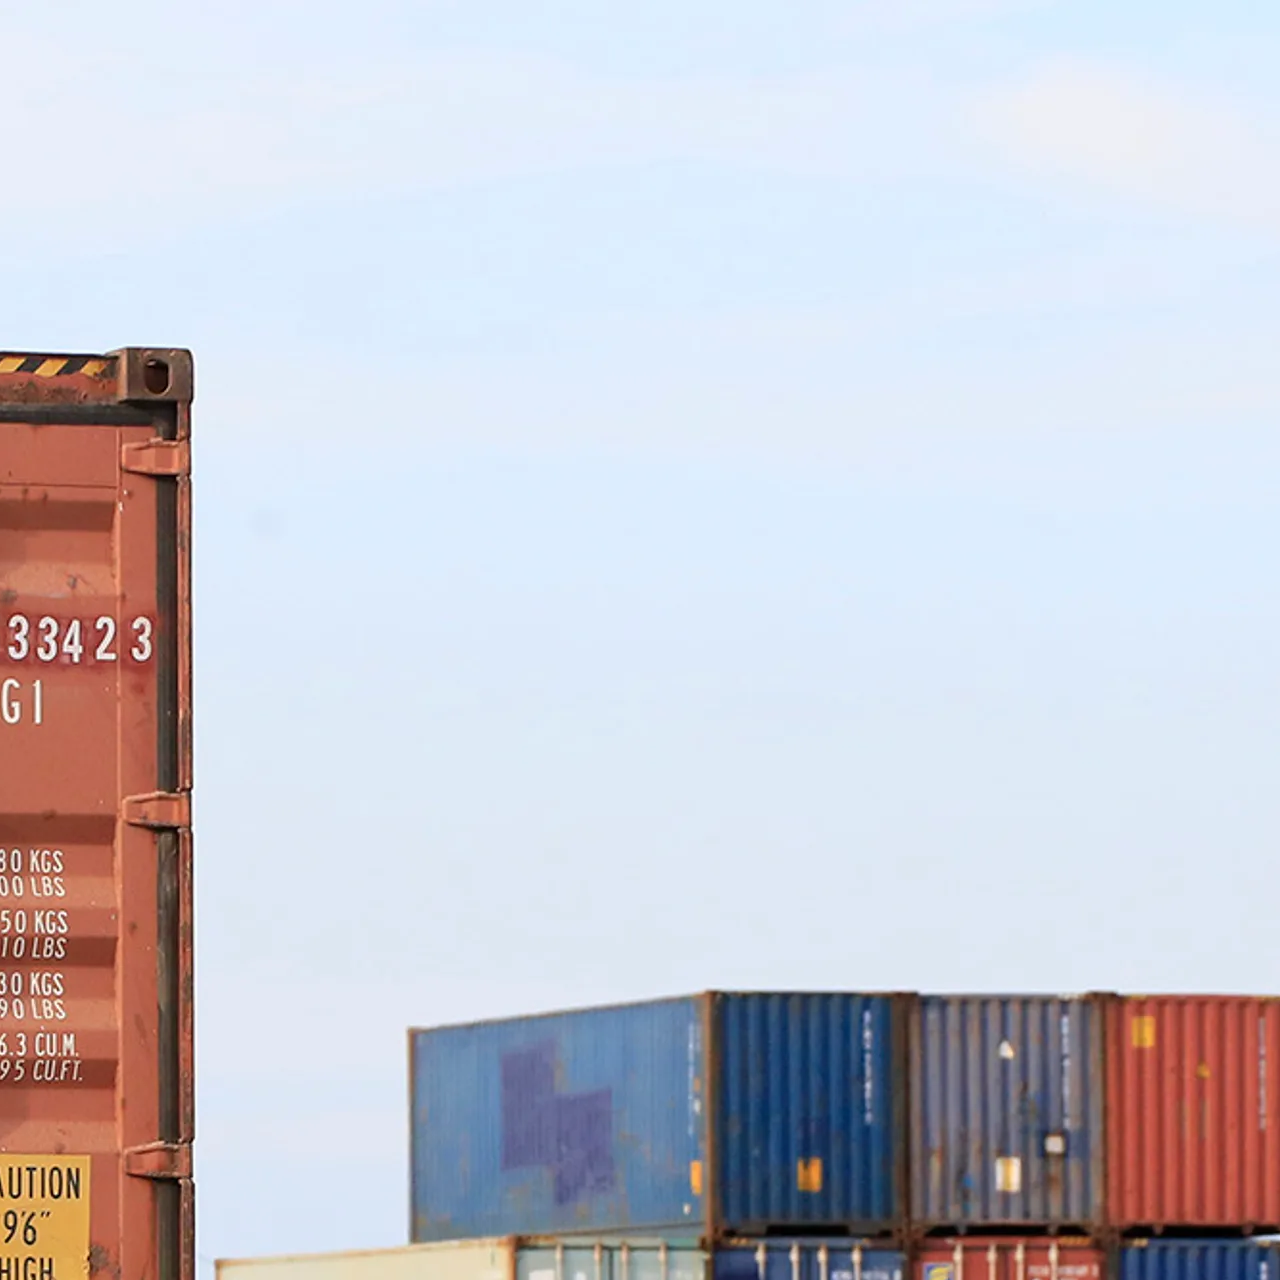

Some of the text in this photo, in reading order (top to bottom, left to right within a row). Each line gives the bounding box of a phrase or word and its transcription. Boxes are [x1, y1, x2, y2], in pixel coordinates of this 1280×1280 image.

[29, 849, 63, 873] KGS
[30, 875, 66, 897] LBS
[34, 909, 69, 935] KGS
[31, 936, 68, 959] LBS
[30, 971, 64, 996] KGS
[31, 998, 66, 1020] LBS
[35, 1032, 79, 1057] CU.M.
[32, 1059, 83, 1081] CU.FT.
